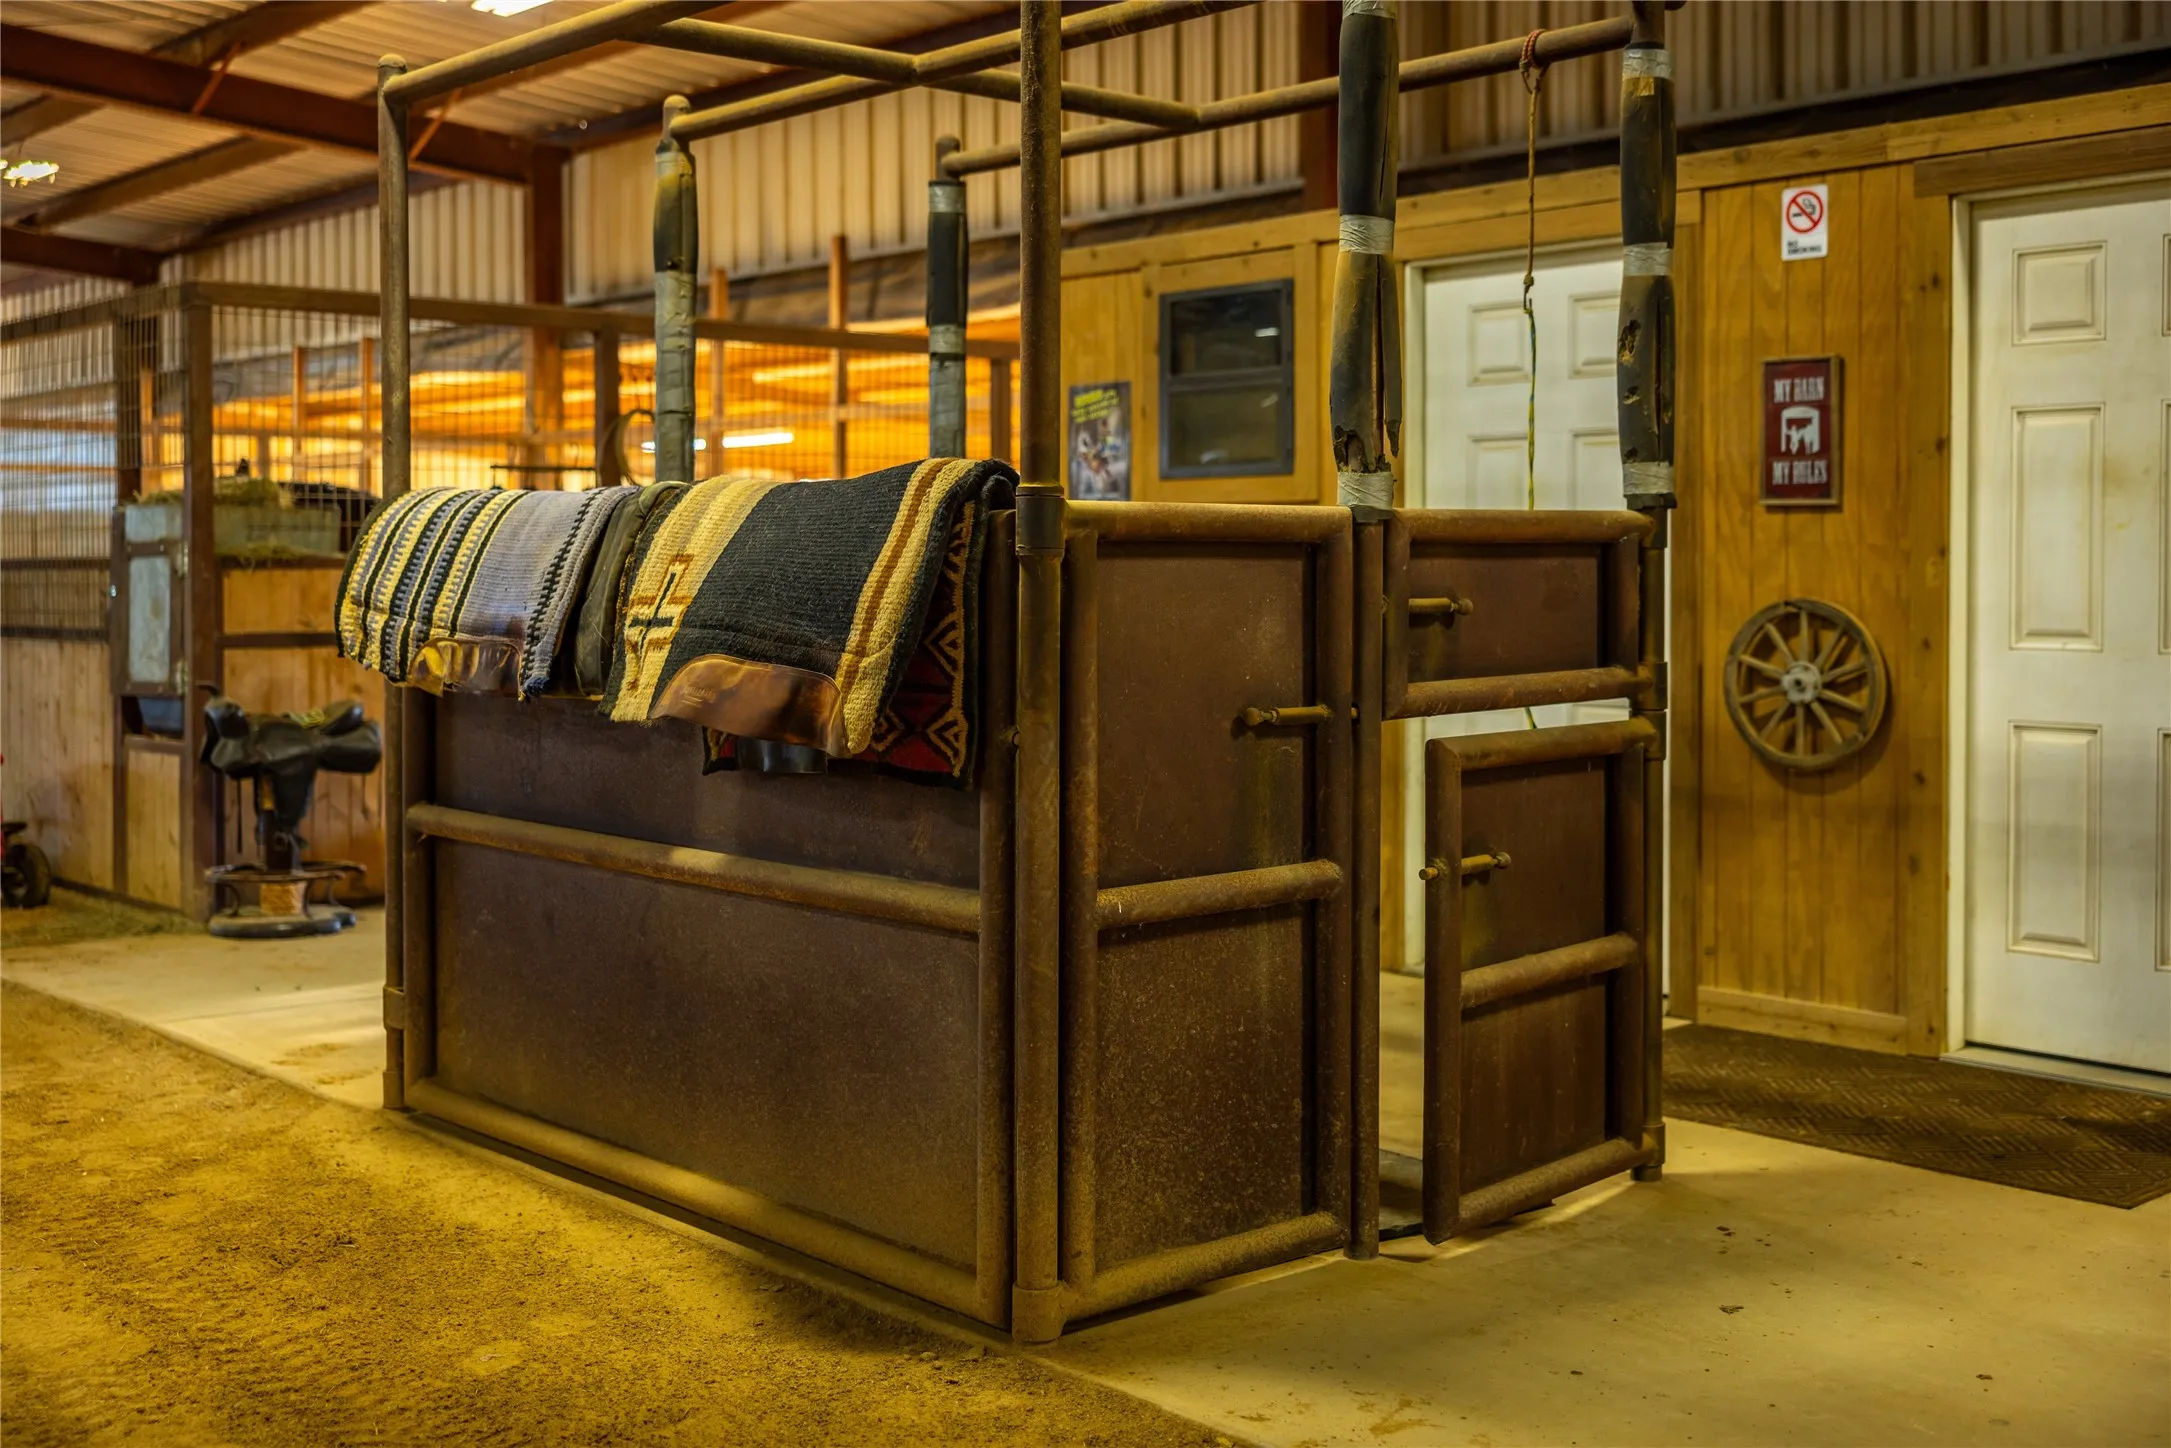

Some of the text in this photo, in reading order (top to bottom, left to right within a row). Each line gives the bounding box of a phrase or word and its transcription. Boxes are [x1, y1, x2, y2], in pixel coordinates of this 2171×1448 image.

[1773, 376, 1825, 403] MY BARN
[1772, 459, 1828, 485] MY RULES
